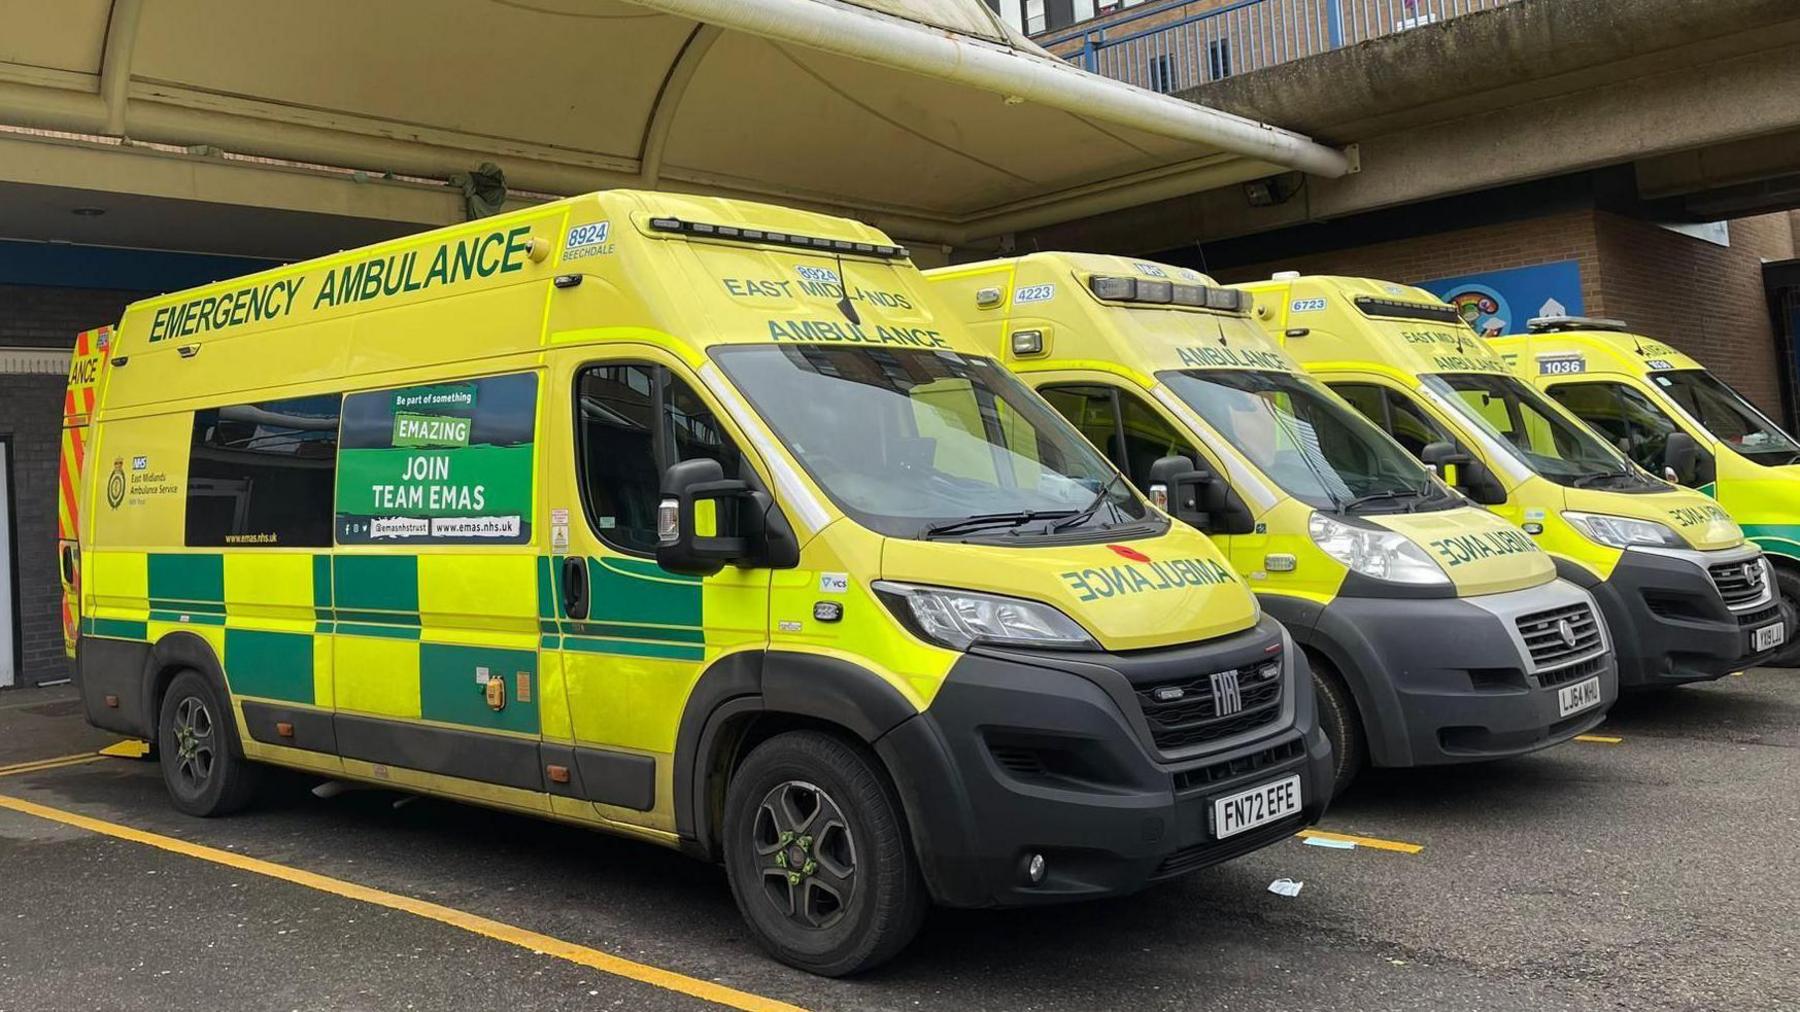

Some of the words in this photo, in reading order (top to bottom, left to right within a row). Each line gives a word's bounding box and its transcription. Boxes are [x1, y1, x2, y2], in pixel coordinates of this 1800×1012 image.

[568, 223, 607, 247] 8924
[562, 243, 615, 261] BEECHDALE
[797, 265, 838, 282] 8924
[148, 276, 304, 343] EMERGENCY
[313, 225, 532, 310] AMBULANCE
[722, 278, 794, 298] EAST
[1018, 285, 1052, 300] 4223
[1293, 299, 1325, 311] 6723
[768, 319, 953, 349] AMBULANCE
[1401, 331, 1435, 344] EAST
[1175, 347, 1292, 371] AMBULANCE
[1545, 361, 1580, 374] 1036
[68, 358, 98, 386] ANCE
[396, 395, 406, 405] Be
[406, 396, 422, 406] part
[423, 393, 432, 404] of
[432, 391, 472, 404] something
[399, 420, 466, 441] EMAZING
[131, 474, 141, 483] East
[142, 472, 166, 482] Midlands
[402, 456, 449, 480] JOIN
[130, 486, 158, 495] Ambulance
[158, 484, 178, 494] Service
[372, 485, 423, 509] TEAM
[429, 485, 485, 511] EMAS
[436, 521, 512, 532] www.emas.nhs.uk
[225, 532, 278, 543] www.emas.nhs.uk
[1210, 669, 1242, 717] FIAT
[1562, 685, 1583, 711] LJ64
[1223, 792, 1265, 832] FN72
[1266, 781, 1295, 818] EFE
